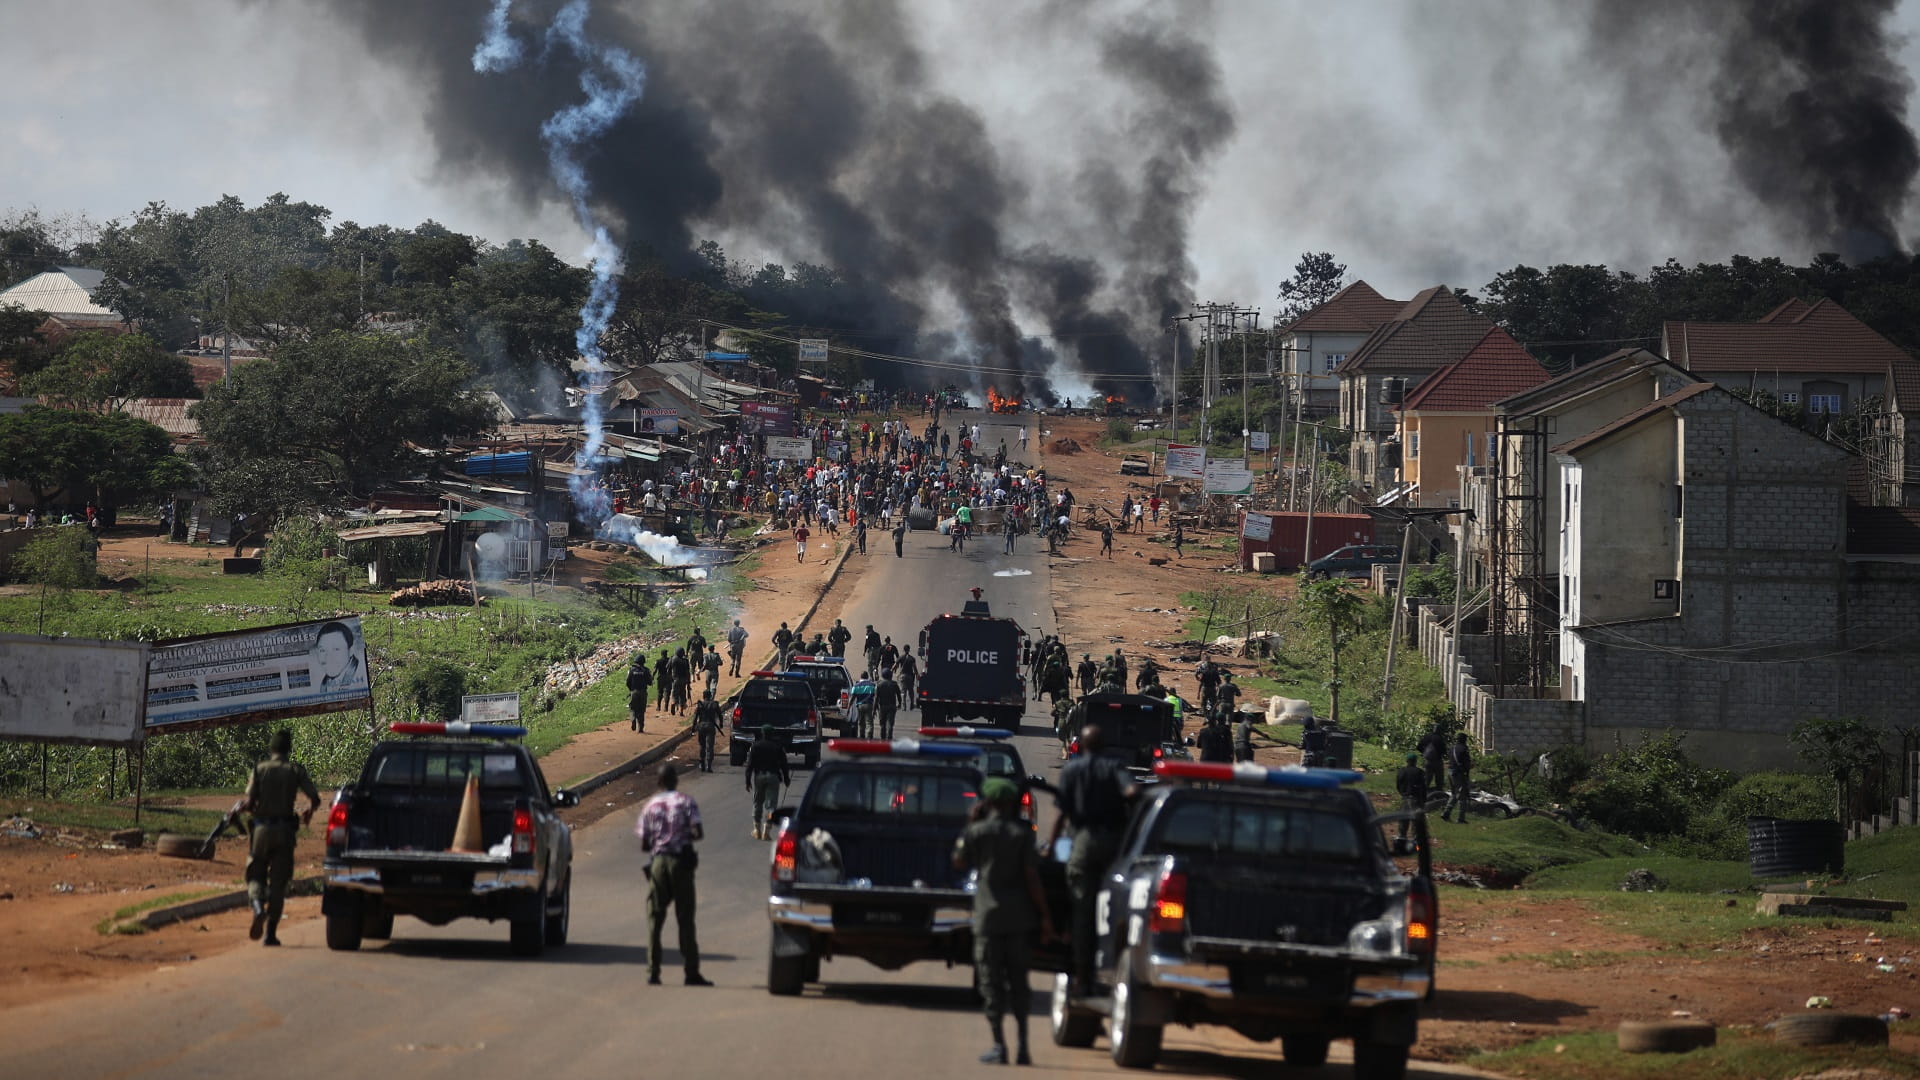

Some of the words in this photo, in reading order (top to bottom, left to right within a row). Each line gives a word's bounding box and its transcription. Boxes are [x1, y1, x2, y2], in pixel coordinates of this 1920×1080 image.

[217, 641, 239, 654] FIRE
[239, 638, 263, 649] AND
[263, 633, 317, 647] MIRACLES
[197, 648, 249, 663] MINISTRY
[947, 649, 998, 664] POLICE
[167, 668, 207, 680] WEEKLY
[209, 661, 265, 676] ACTIVITIES
